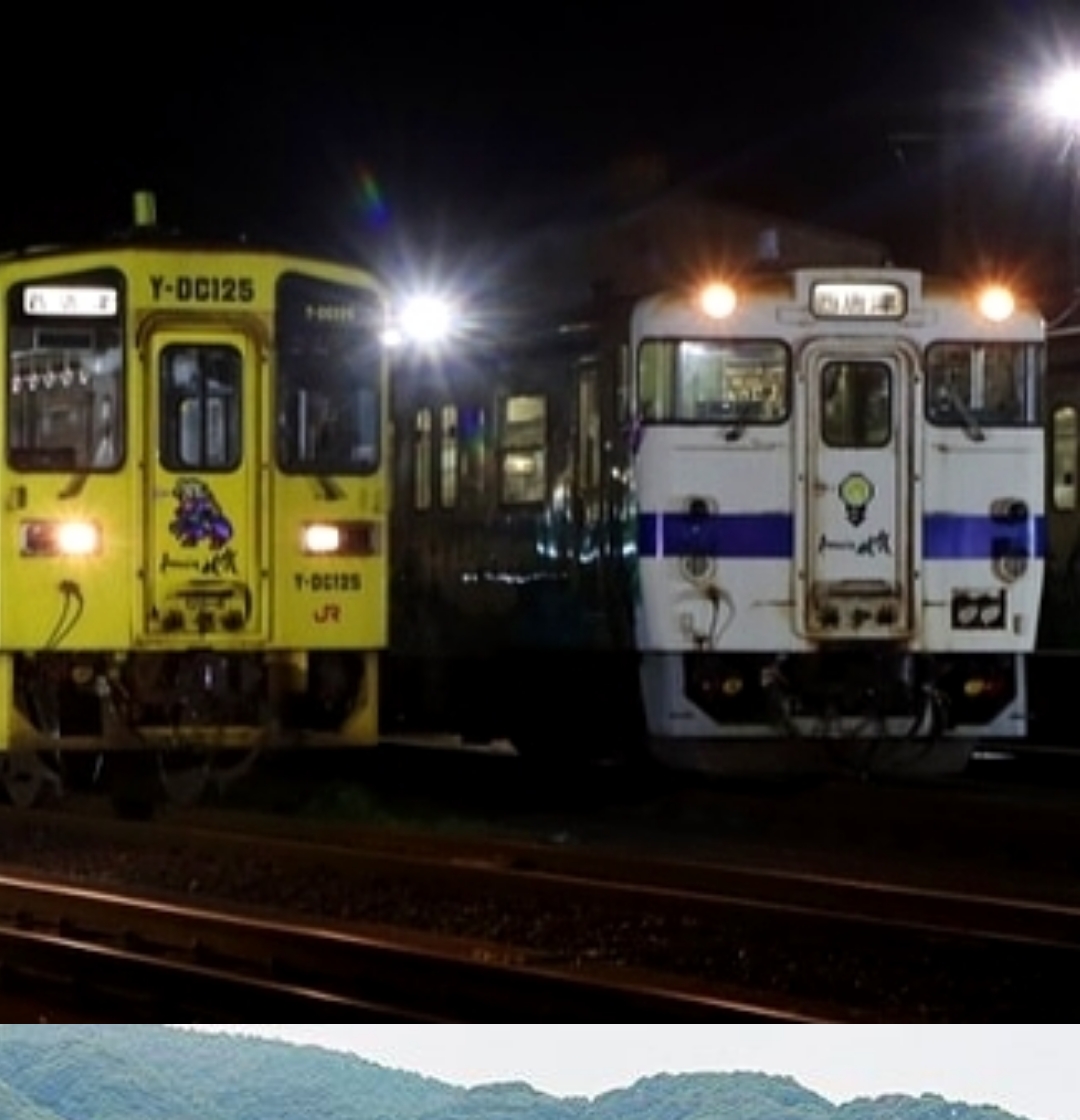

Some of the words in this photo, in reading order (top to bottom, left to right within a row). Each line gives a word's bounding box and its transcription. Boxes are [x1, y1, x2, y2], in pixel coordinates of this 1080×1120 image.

[150, 275, 255, 303] Y-DC125
[294, 573, 362, 591] Y-DC125
[313, 604, 342, 624] JR
